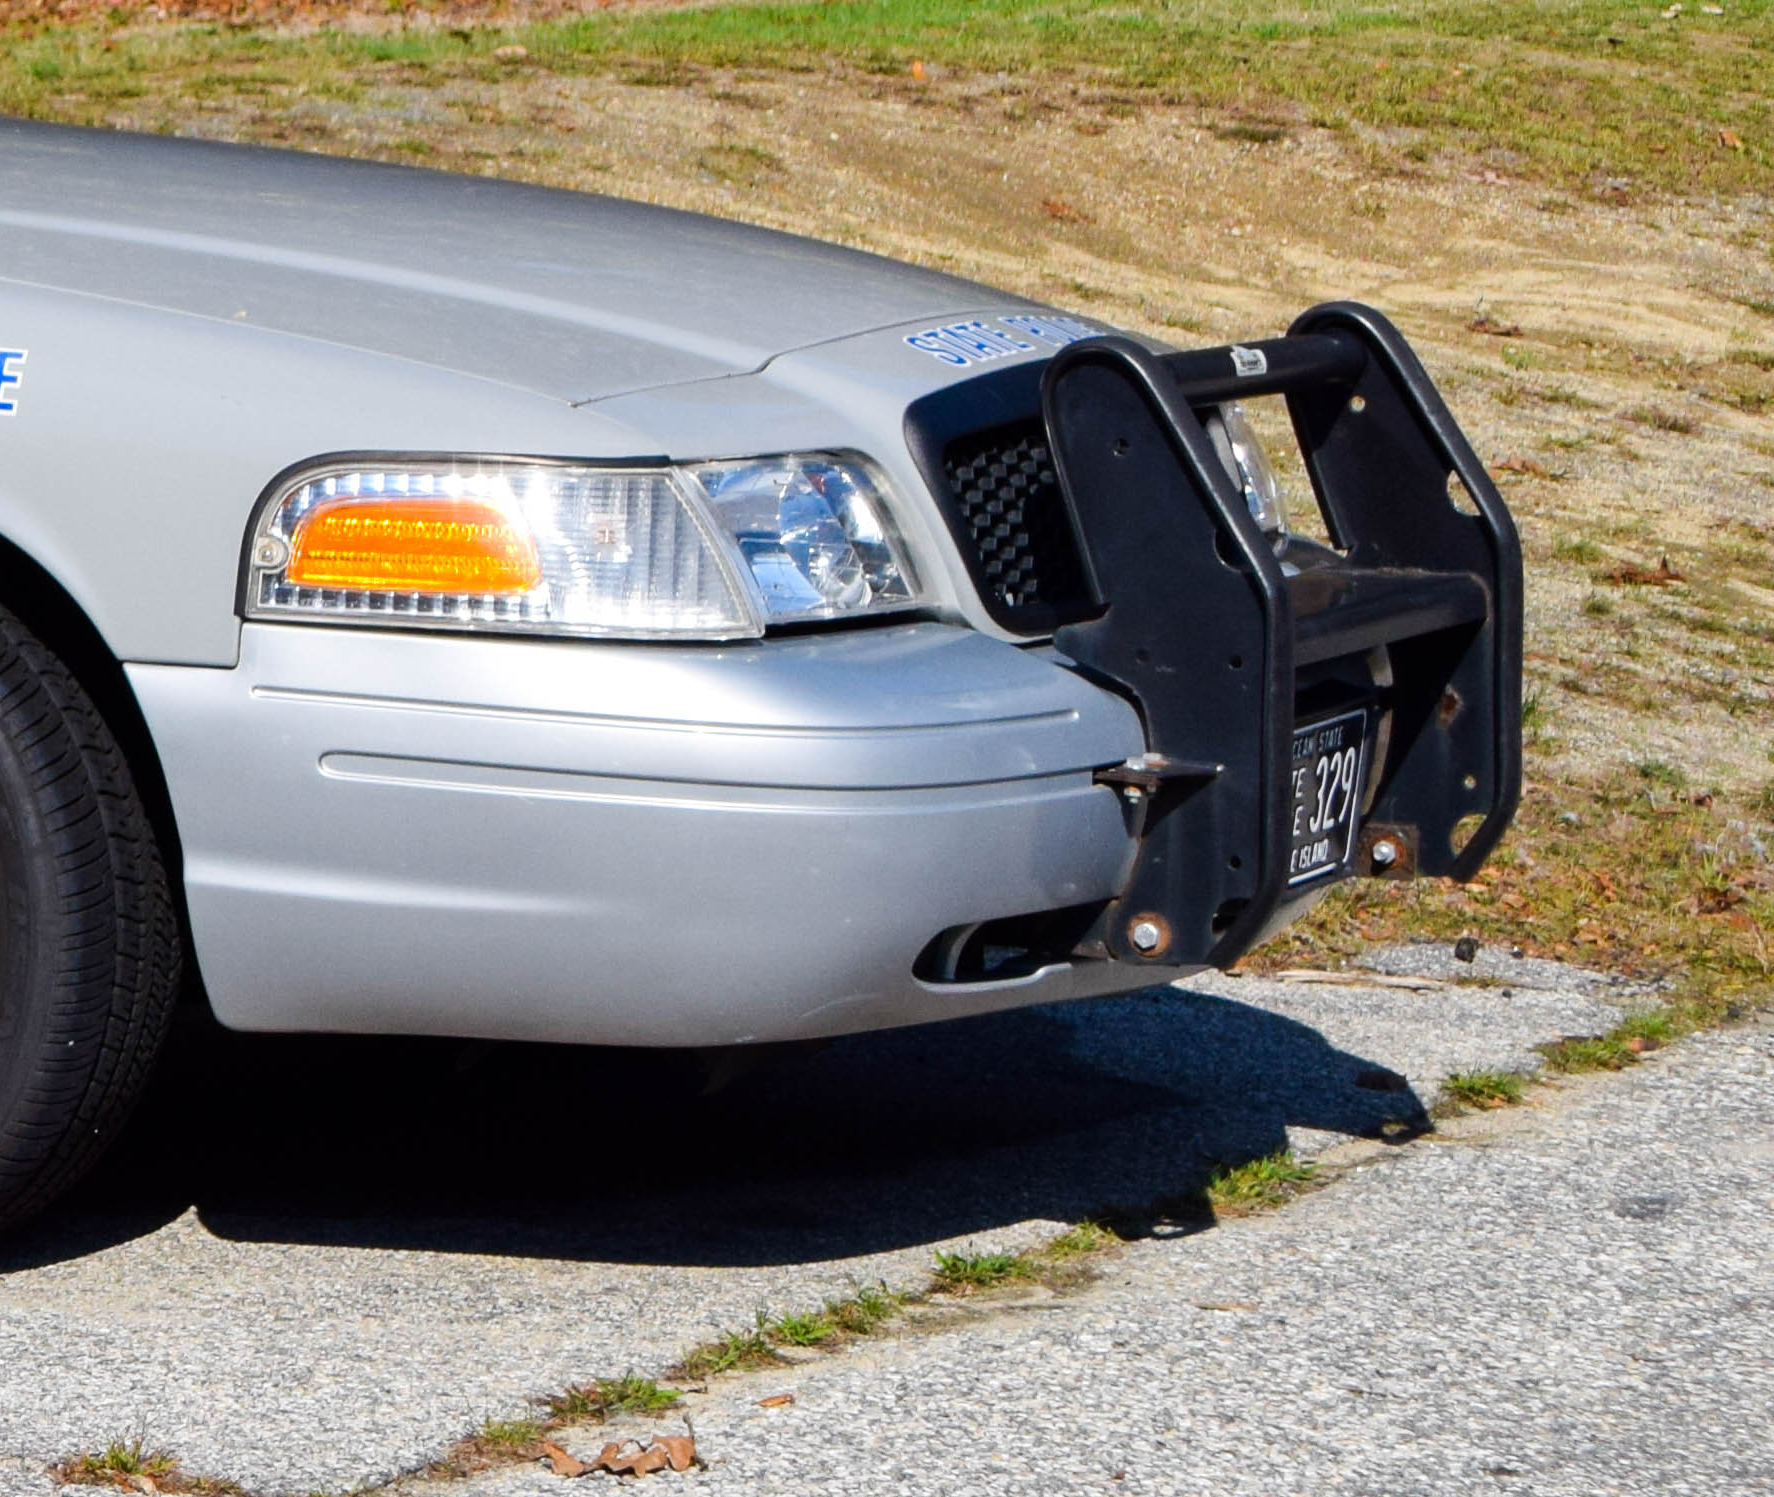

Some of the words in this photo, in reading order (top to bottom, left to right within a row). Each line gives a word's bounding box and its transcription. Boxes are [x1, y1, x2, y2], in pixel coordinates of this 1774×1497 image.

[902, 320, 1036, 368] STATE
[1292, 736, 1314, 761] CEAN
[1309, 746, 1356, 833] 329
[1299, 838, 1329, 870] ISLAND
